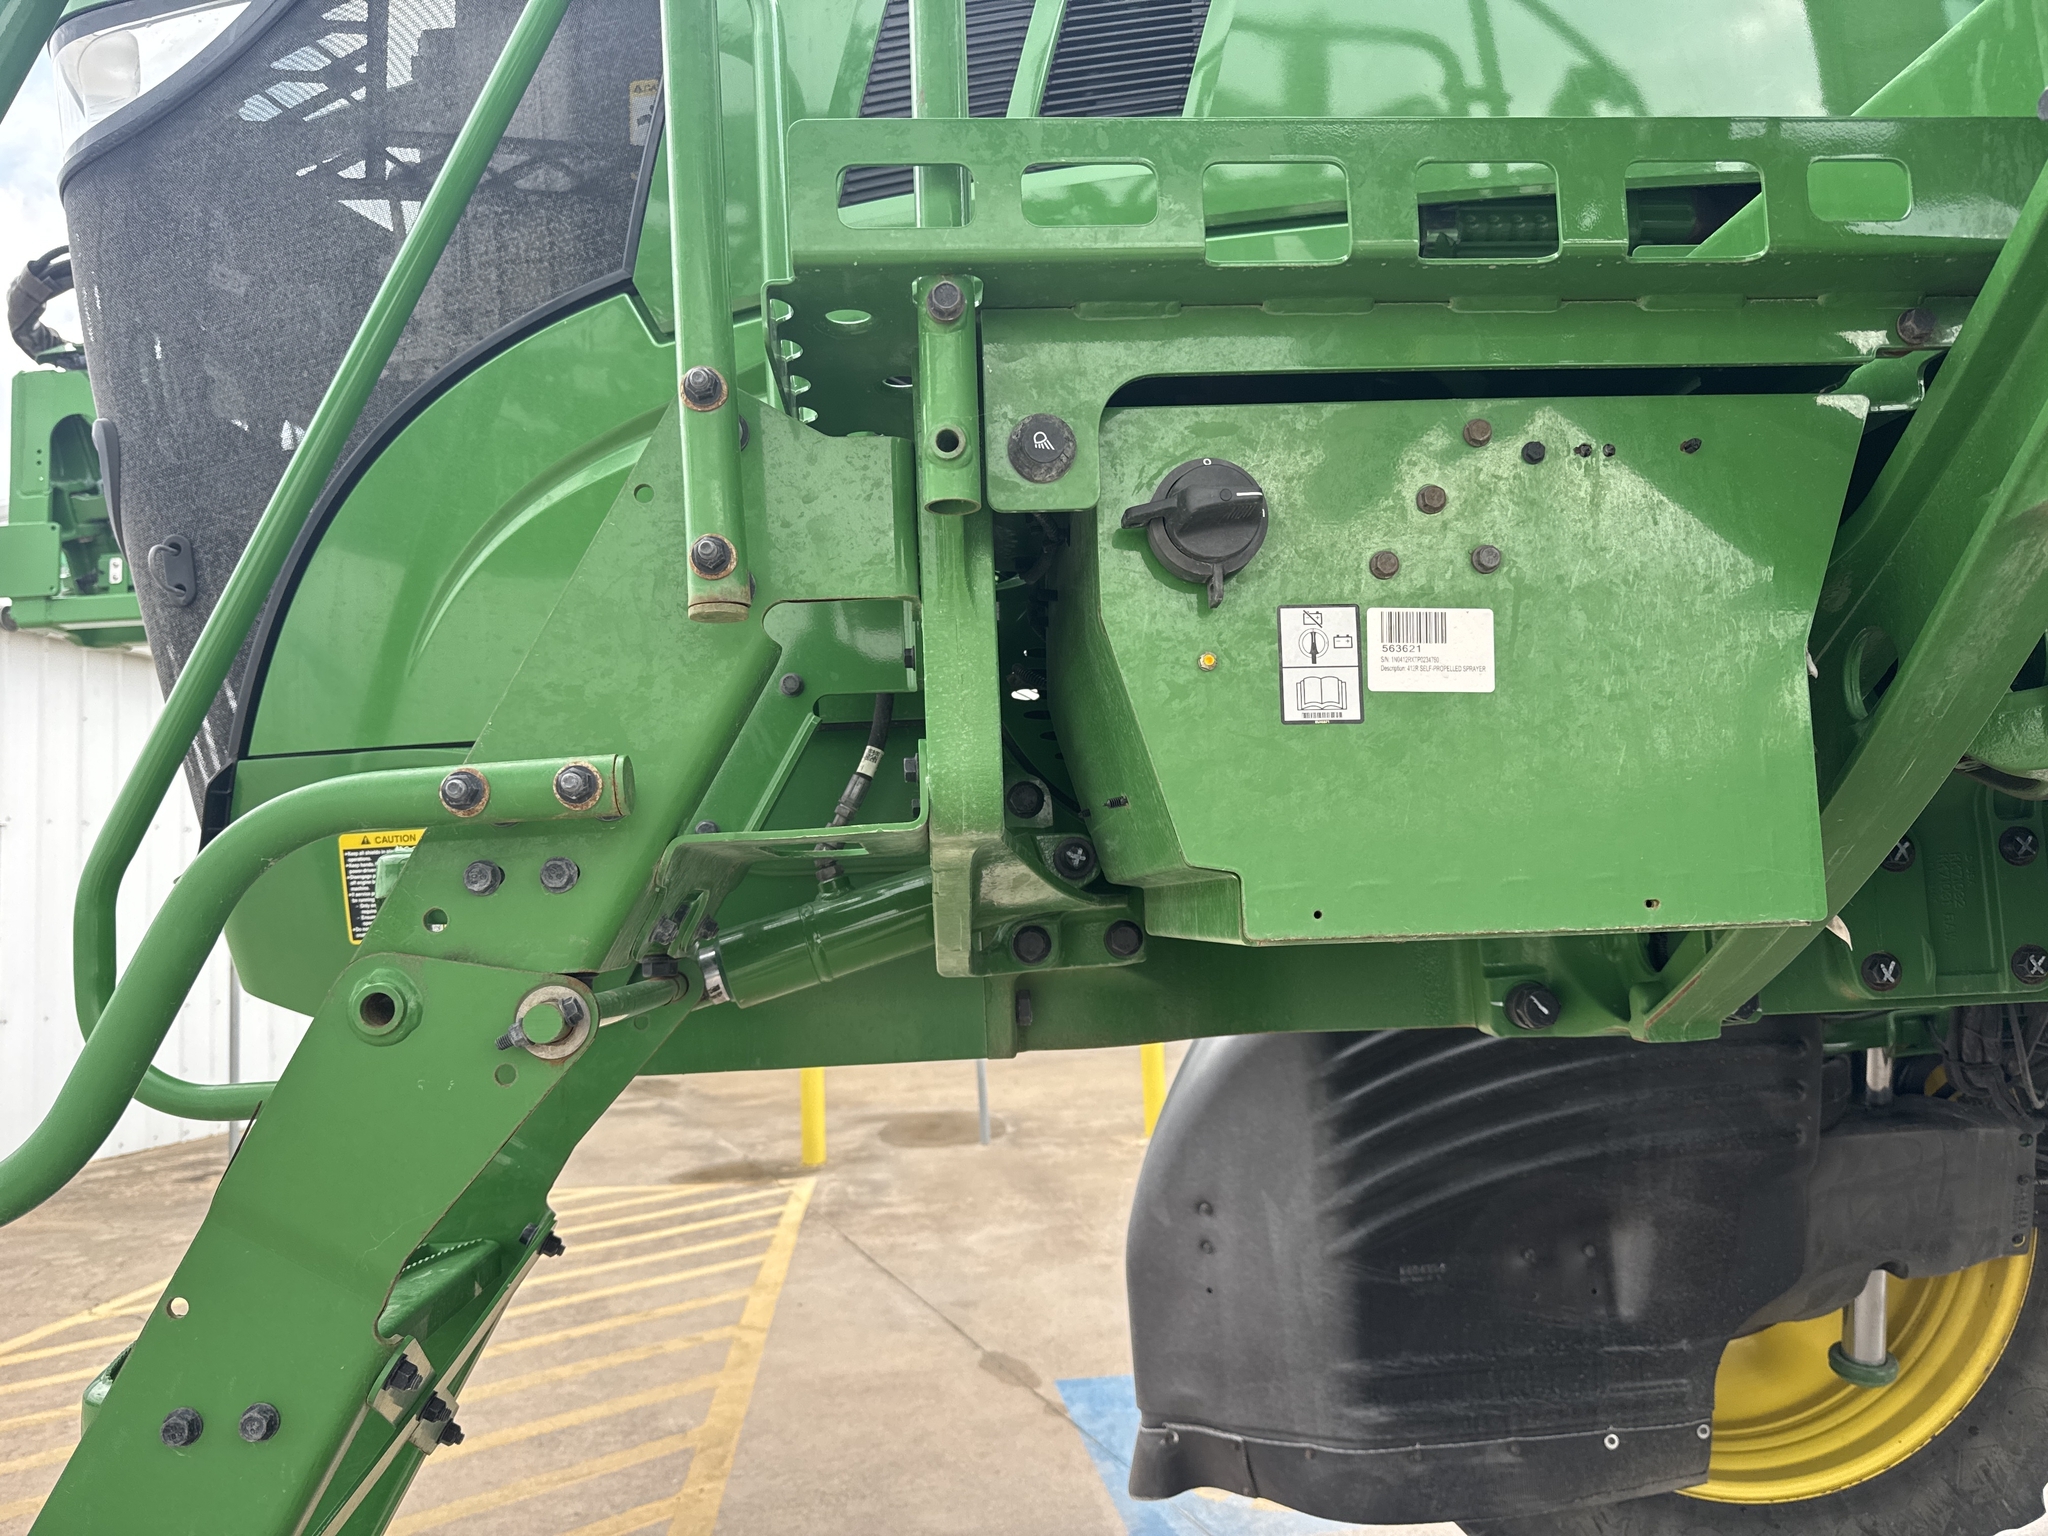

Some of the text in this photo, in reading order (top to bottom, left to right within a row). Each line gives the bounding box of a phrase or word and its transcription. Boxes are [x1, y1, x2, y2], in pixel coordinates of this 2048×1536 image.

[1382, 644, 1421, 653] 563621
[1380, 664, 1406, 672] Description:
[374, 834, 416, 844] CAUTION
